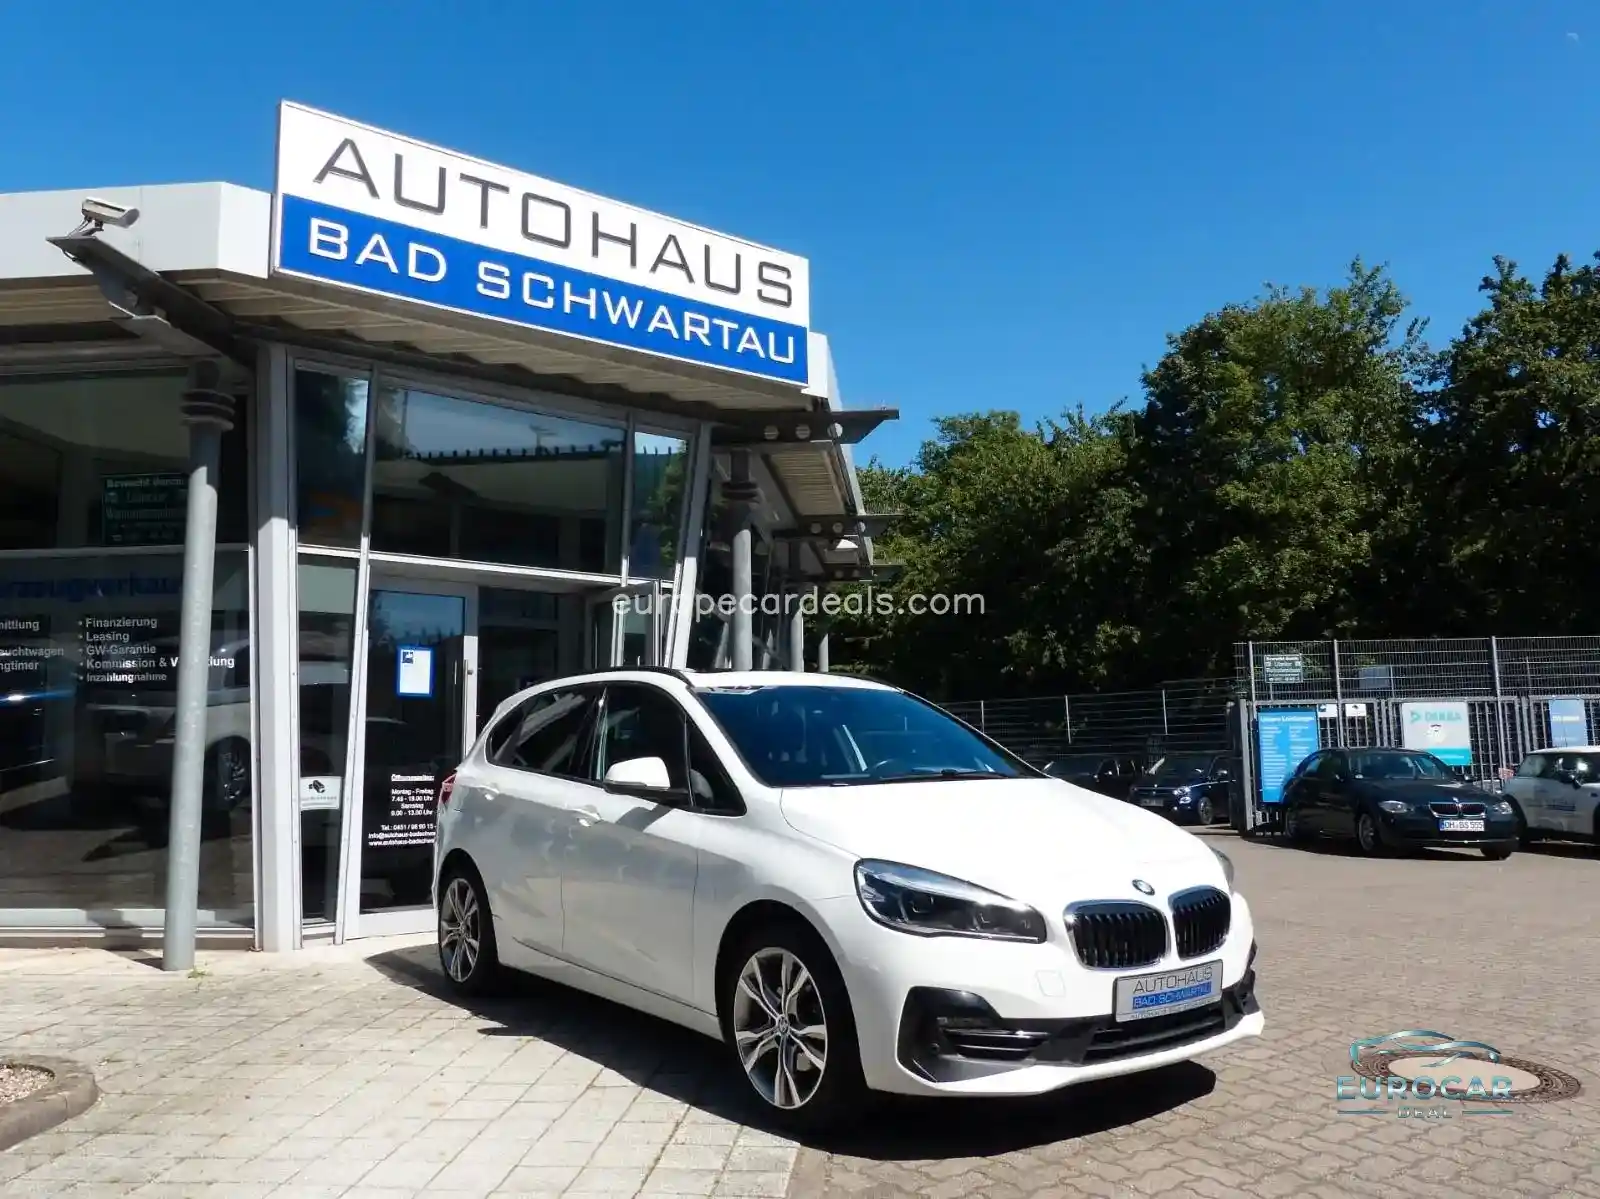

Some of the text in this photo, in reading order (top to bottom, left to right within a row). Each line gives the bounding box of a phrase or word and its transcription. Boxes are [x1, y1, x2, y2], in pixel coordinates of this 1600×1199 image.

[313, 137, 794, 308] AUTOHAUS
[308, 218, 796, 365] BAD SCHWARTAU
[85, 617, 158, 629] Finanzierung
[86, 631, 130, 642] Leasing
[86, 645, 156, 656] GW-Garantie
[86, 658, 156, 669] Kommission
[159, 657, 167, 666] &
[86, 671, 167, 684] Inzahlungnahme
[1133, 966, 1213, 994] AUTOHAUS
[1133, 995, 1156, 1008] BAD
